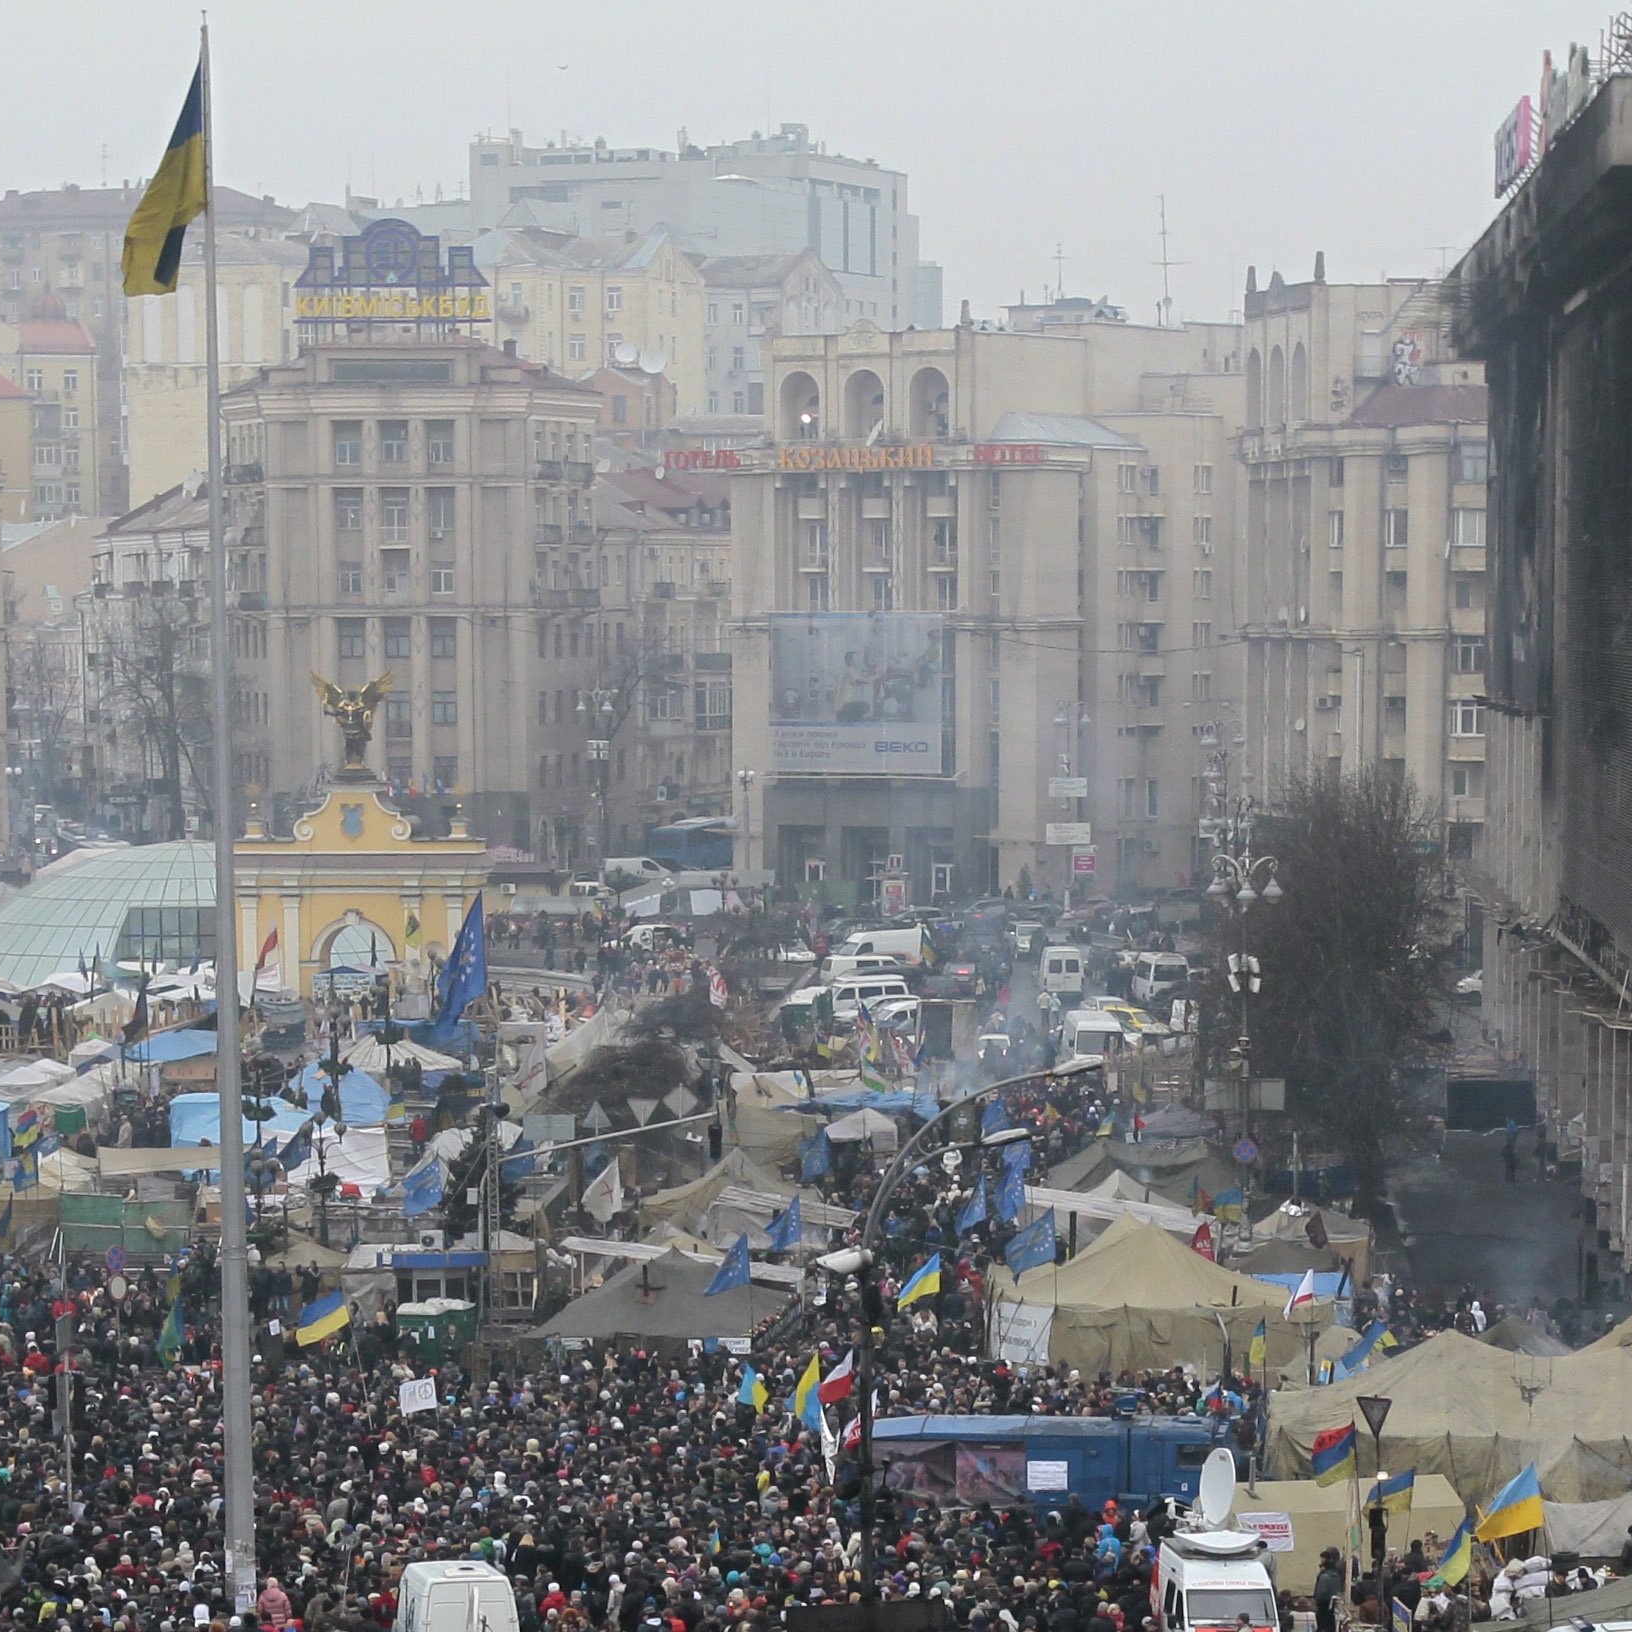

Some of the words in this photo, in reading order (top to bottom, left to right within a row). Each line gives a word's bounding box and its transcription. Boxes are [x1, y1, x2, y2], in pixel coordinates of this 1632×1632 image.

[297, 295, 490, 318] КИЇВМІСЬКБУД
[665, 449, 741, 469] ГОТЕЛЬ
[778, 442, 934, 474] КОЗАЦЬКИЙ
[974, 445, 1042, 464] HOTEL
[874, 741, 928, 753] BEKO
